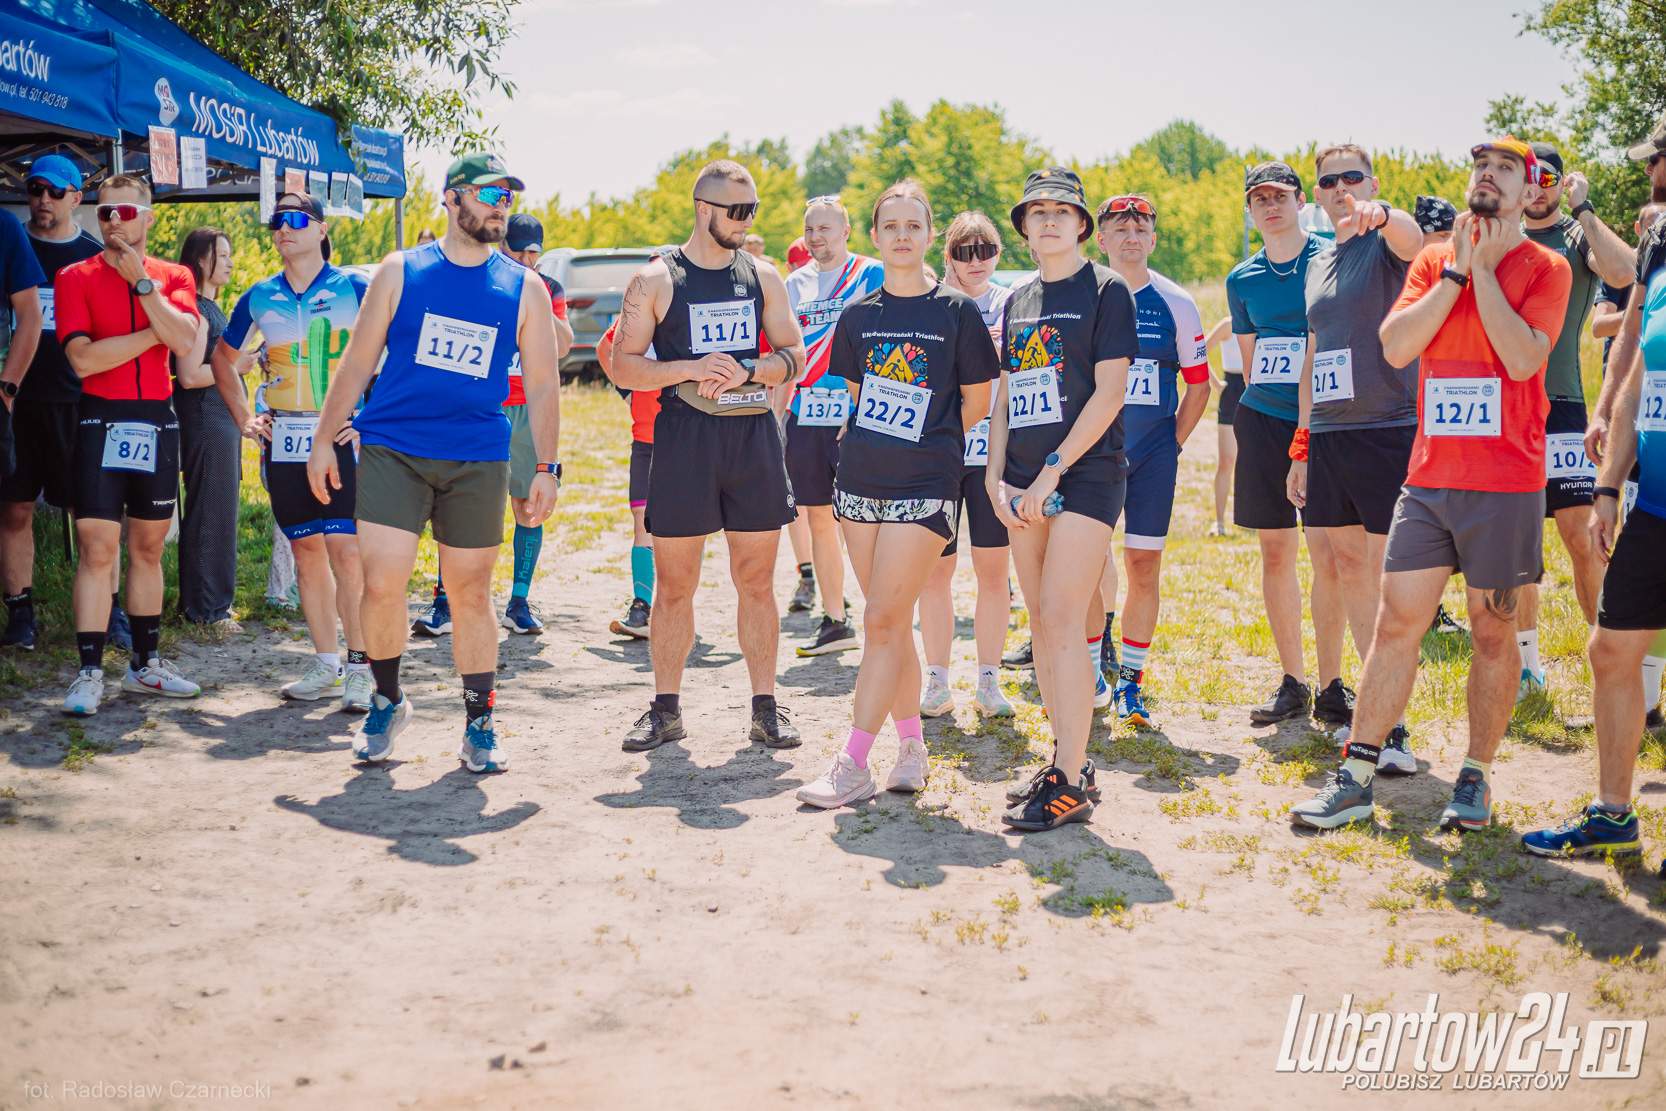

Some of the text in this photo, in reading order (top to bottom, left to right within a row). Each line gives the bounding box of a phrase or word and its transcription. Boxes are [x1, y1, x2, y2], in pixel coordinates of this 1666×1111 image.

[0, 39, 50, 82] artów
[250, 112, 319, 166] Lubartów
[701, 320, 750, 343] 11/1
[427, 336, 484, 366] 11/2
[1260, 356, 1291, 375] 2/2
[879, 388, 908, 400] TRIATHLON
[1125, 377, 1152, 396] /1
[717, 391, 768, 405] BELTO
[1012, 391, 1052, 417] 22/1
[805, 402, 843, 419] 13/2
[864, 397, 917, 430] 22/2
[1434, 402, 1492, 425] 12/1
[118, 441, 150, 462] 8/2
[284, 436, 313, 454] 8/1
[966, 438, 988, 457] /2
